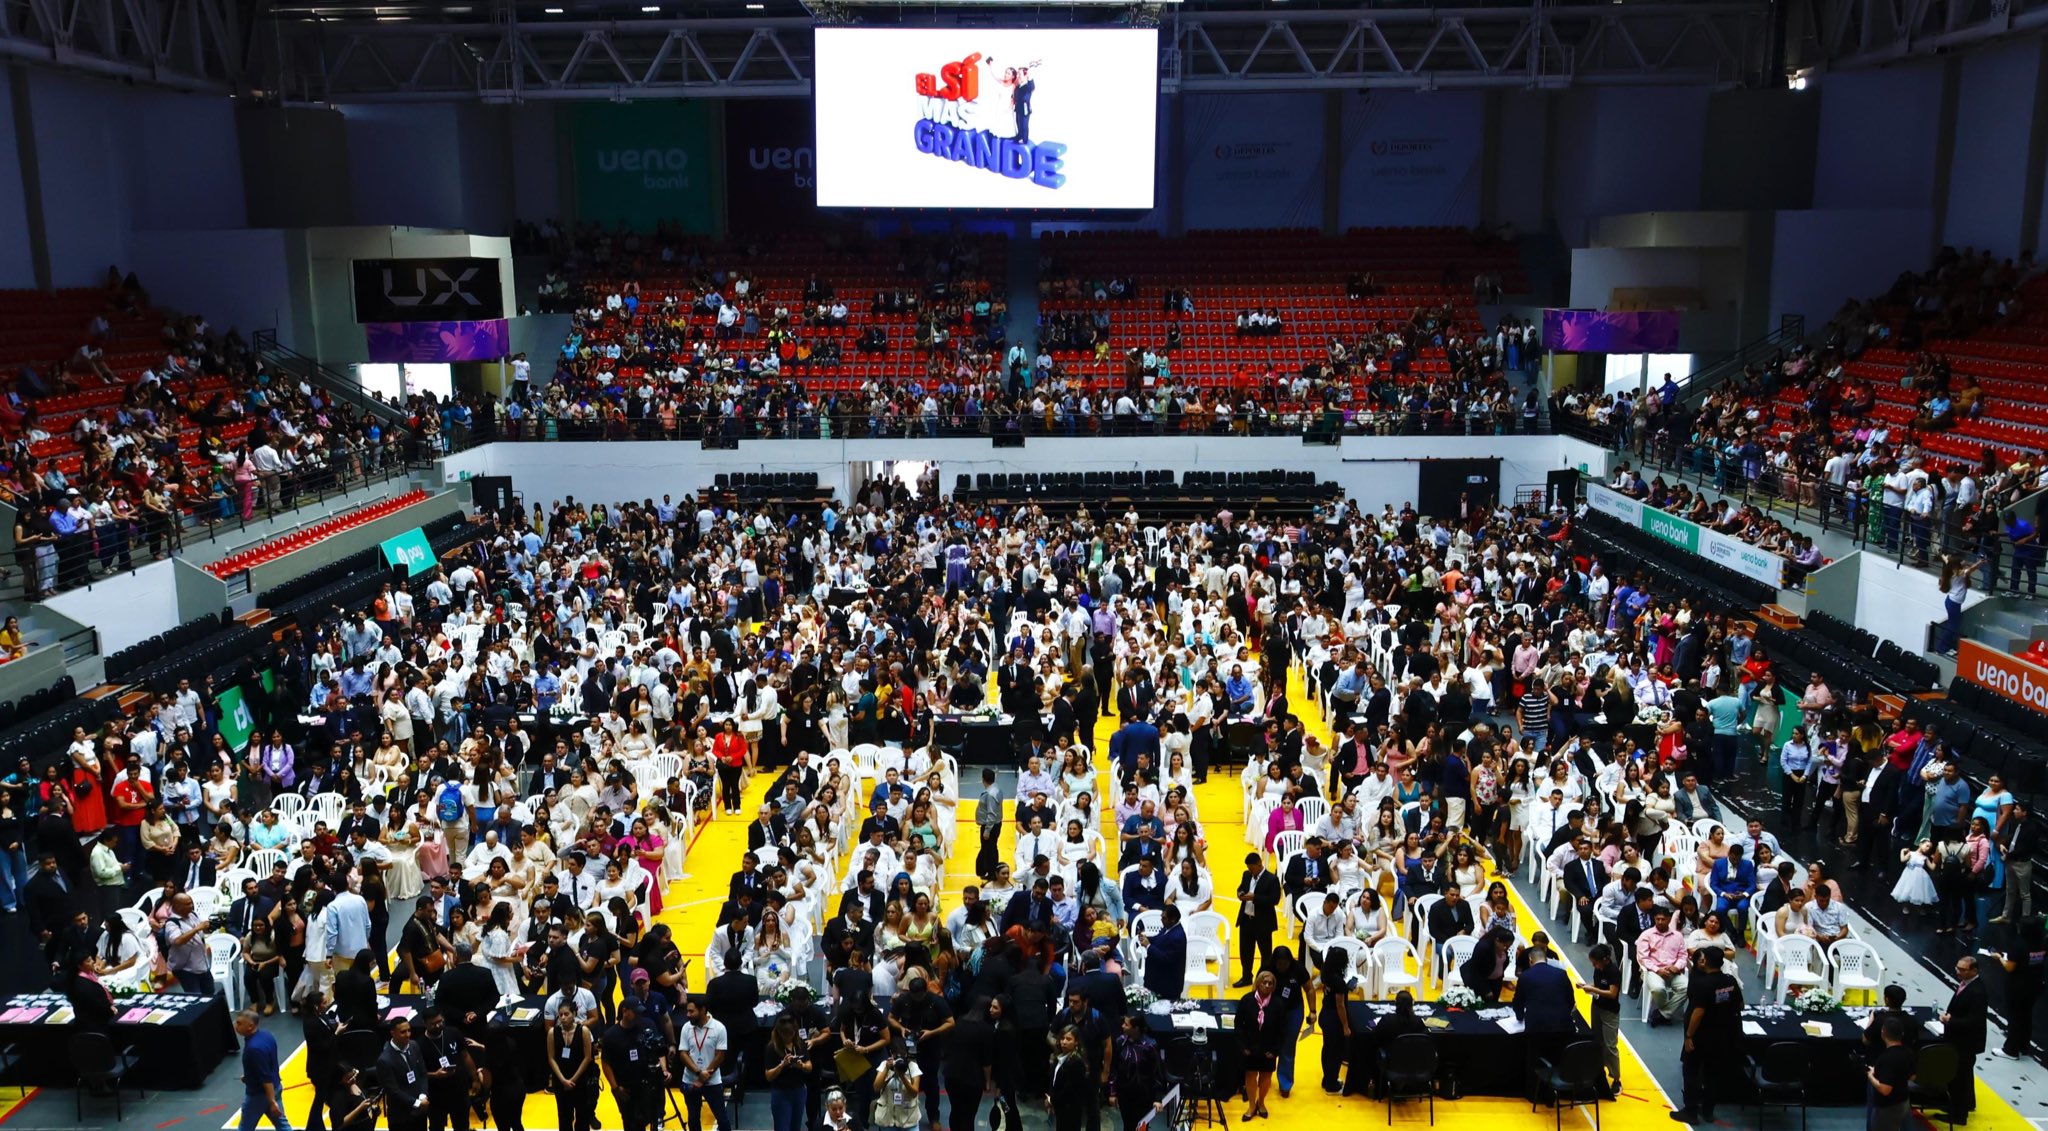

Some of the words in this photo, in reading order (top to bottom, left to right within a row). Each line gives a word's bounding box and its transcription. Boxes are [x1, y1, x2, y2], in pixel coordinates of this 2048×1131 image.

[915, 73, 941, 98] EL
[940, 51, 982, 102] SÍ
[597, 147, 689, 172] ueno
[749, 147, 813, 170] uen
[914, 117, 1067, 190] GRANDE
[643, 172, 689, 190] bank
[382, 267, 482, 306] UX
[1651, 517, 1669, 537] ueno
[1669, 520, 1689, 545] bank
[407, 544, 425, 564] pay
[1740, 550, 1754, 564] ueno
[1754, 553, 1768, 569] bank
[1976, 660, 2019, 696] ueno
[2022, 671, 2048, 710] ba
